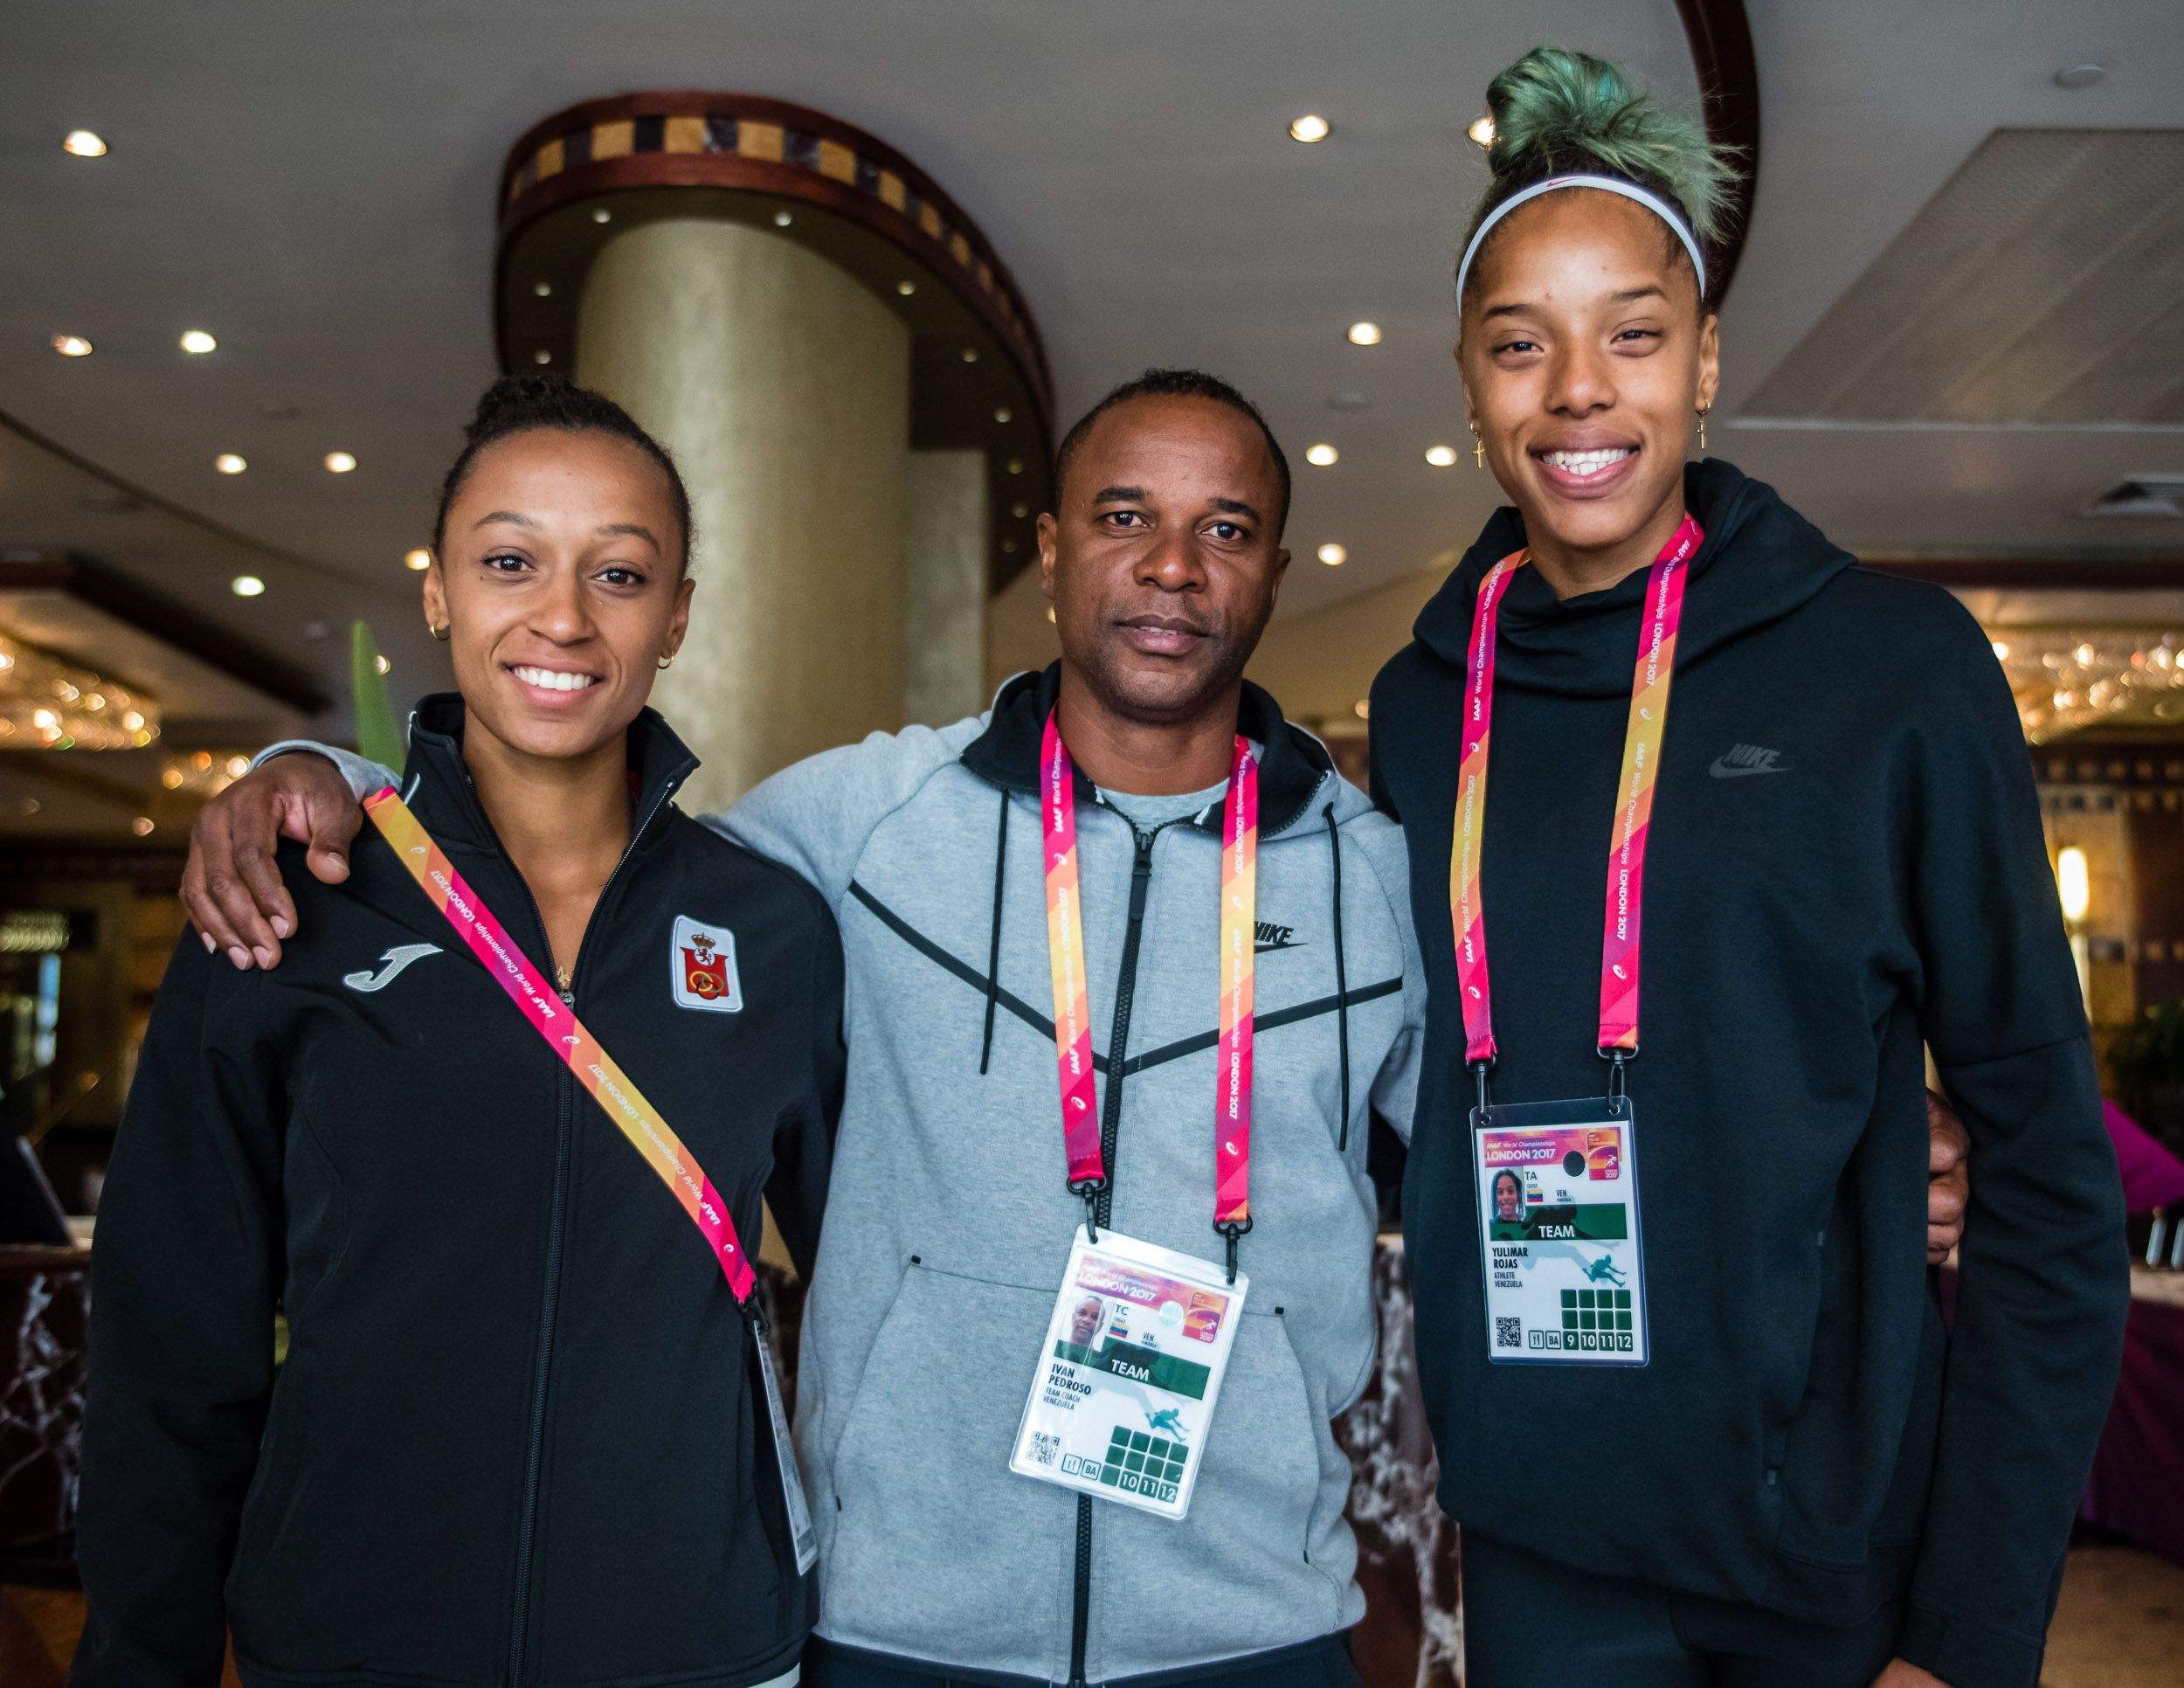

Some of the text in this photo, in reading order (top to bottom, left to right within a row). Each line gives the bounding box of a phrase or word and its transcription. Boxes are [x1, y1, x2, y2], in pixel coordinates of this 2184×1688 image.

[1677, 538, 1690, 557] IAAF
[1482, 576, 1499, 611] LONDON
[1655, 566, 1673, 619] Championships
[1476, 612, 1489, 669] Championships
[1650, 622, 1664, 663] LONDON
[1475, 669, 1483, 694] World
[1646, 661, 1658, 685] 2017
[1723, 744, 1780, 770] NIKE
[1052, 781, 1061, 804] World
[1236, 770, 1246, 815] Championships
[1053, 806, 1063, 833] IAAF
[1235, 817, 1245, 853] LONDON
[1616, 740, 1646, 941] IAAF World Championships LONDON 2017
[1234, 852, 1244, 875] 2017
[1461, 774, 1476, 963] IAAF World Championships LONDON 2017
[431, 868, 556, 1018] IAAF World Championships LONDON 2017
[1254, 920, 1295, 946] NIKE
[1231, 985, 1241, 1048] Championships
[1067, 1018, 1077, 1047] World
[1068, 1046, 1081, 1075] IAAF
[1230, 1051, 1241, 1095] LONDON
[1229, 1094, 1239, 1120] 2017
[588, 1062, 722, 1225] IAAF World Championships LONDON 2017
[1487, 1148, 1555, 1160] LONDON 2017
[1524, 1171, 1538, 1180] TA
[1538, 1225, 1574, 1237] TEAM
[1492, 1247, 1528, 1257] YULIMAR
[1493, 1259, 1518, 1269] ROJAS
[1076, 1270, 1129, 1295] LONDON
[1129, 1286, 1157, 1302] 2017
[1116, 1304, 1130, 1316] TC
[1143, 1332, 1154, 1342] VEN
[1549, 1334, 1632, 1348] BA 9 10 11 12
[1051, 1363, 1075, 1378] IVAN
[1111, 1359, 1150, 1381] TEAM
[1045, 1387, 1081, 1403] TEAM COACH
[1048, 1374, 1092, 1394] PEDROSO
[1043, 1394, 1075, 1410] VENEZUELA
[1085, 1464, 1176, 1501] BA 10 11 12
